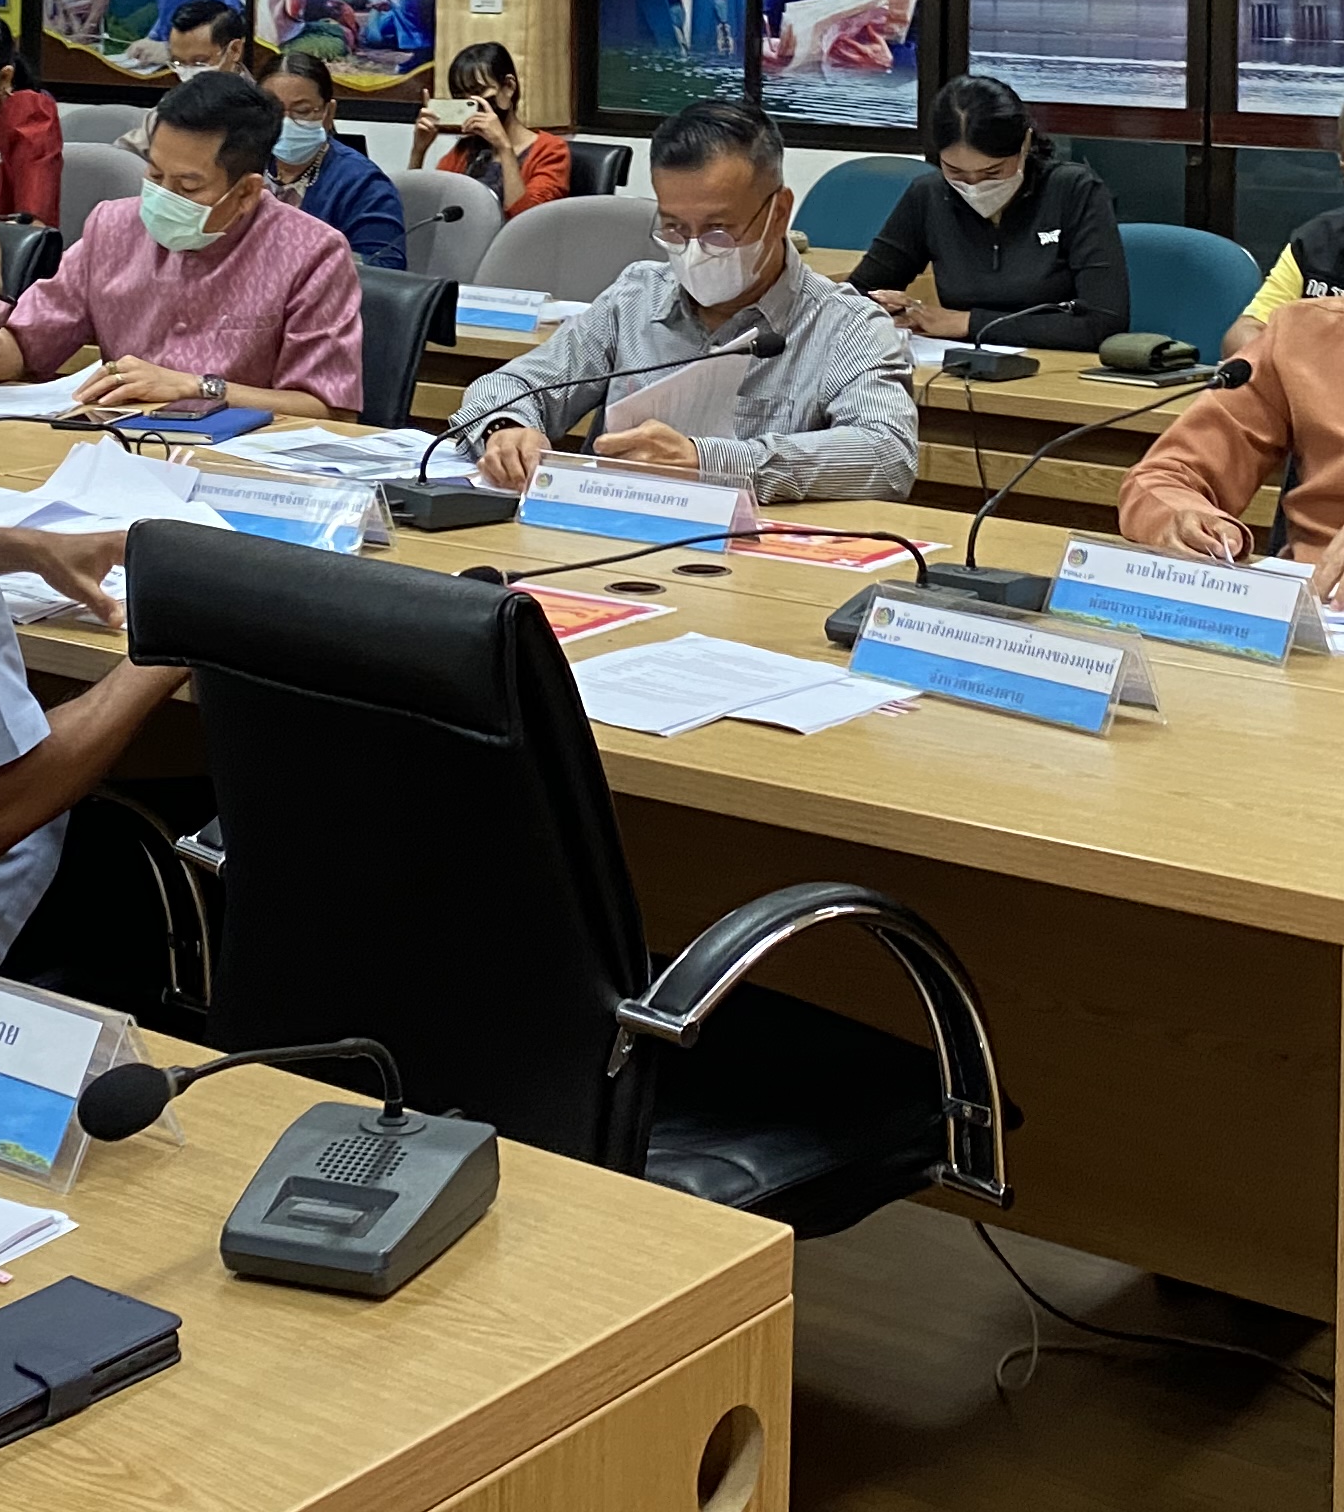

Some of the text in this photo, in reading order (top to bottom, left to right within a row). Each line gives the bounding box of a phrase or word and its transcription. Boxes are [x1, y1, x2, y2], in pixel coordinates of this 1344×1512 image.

[577, 479, 690, 508] ปลัดจังหวัดหนองคาย
[1125, 560, 1199, 587] นายไพโรจน์
[895, 612, 1118, 676] พัฒนาสังคมและความมั่นคงของมนุษย์
[928, 668, 1026, 704] จังหวัดหนองคาย
